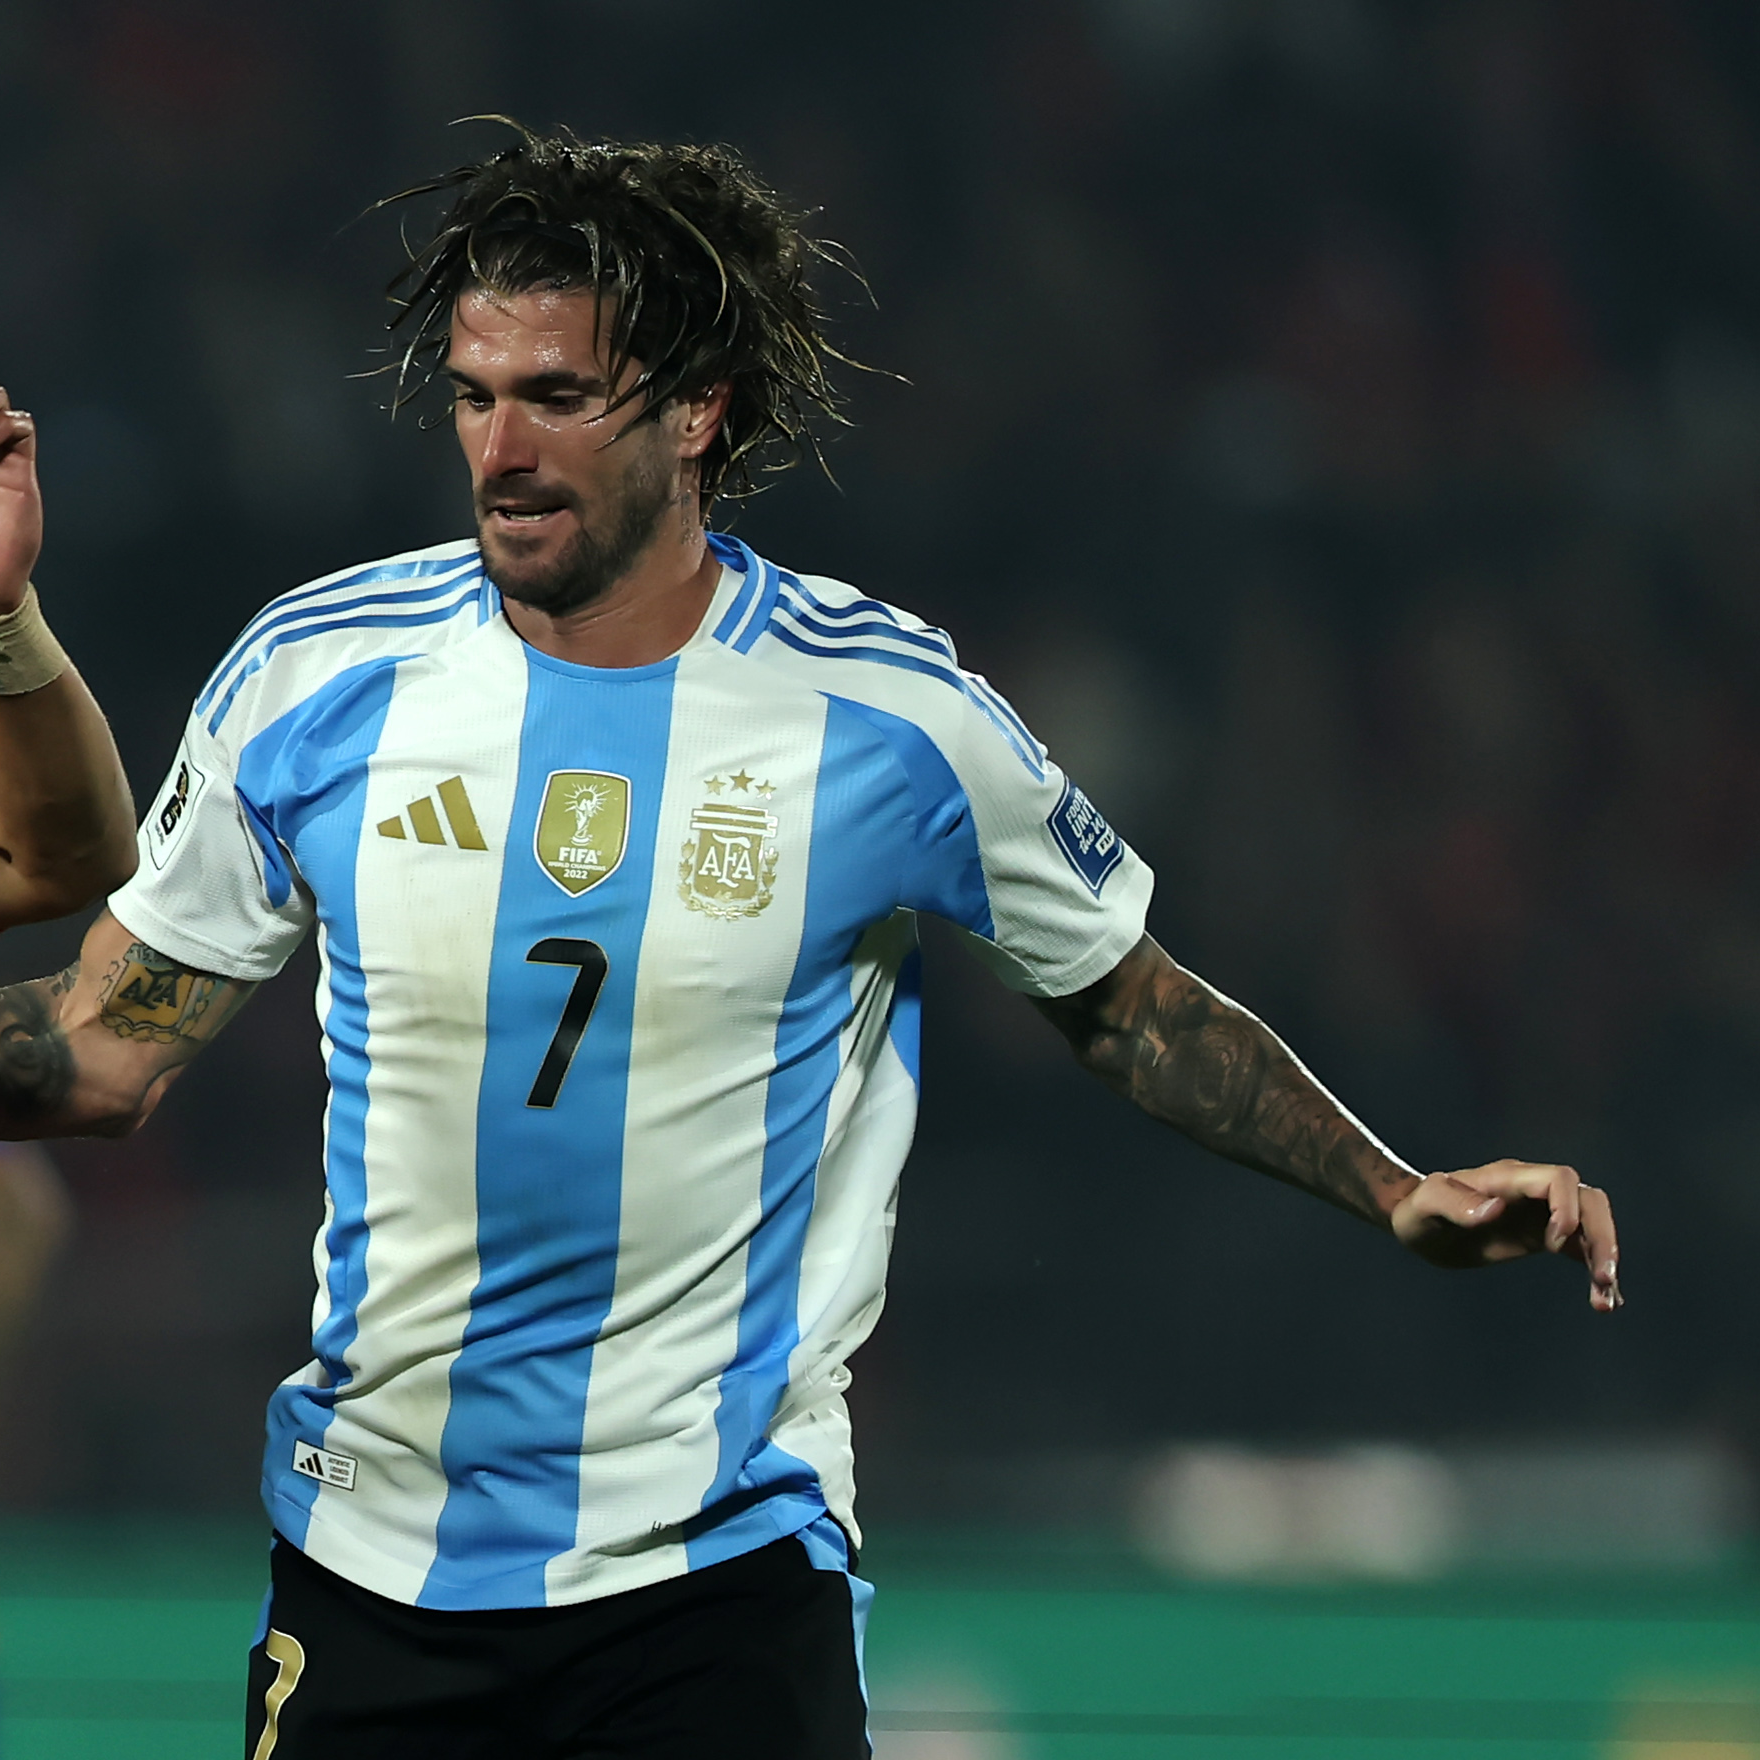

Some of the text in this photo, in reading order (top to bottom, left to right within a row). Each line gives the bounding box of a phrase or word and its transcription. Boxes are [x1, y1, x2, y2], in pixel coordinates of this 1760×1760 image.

[558, 846, 599, 865] FIFA
[563, 868, 588, 880] 2022
[697, 832, 756, 889] AFA
[524, 936, 610, 1110] 7
